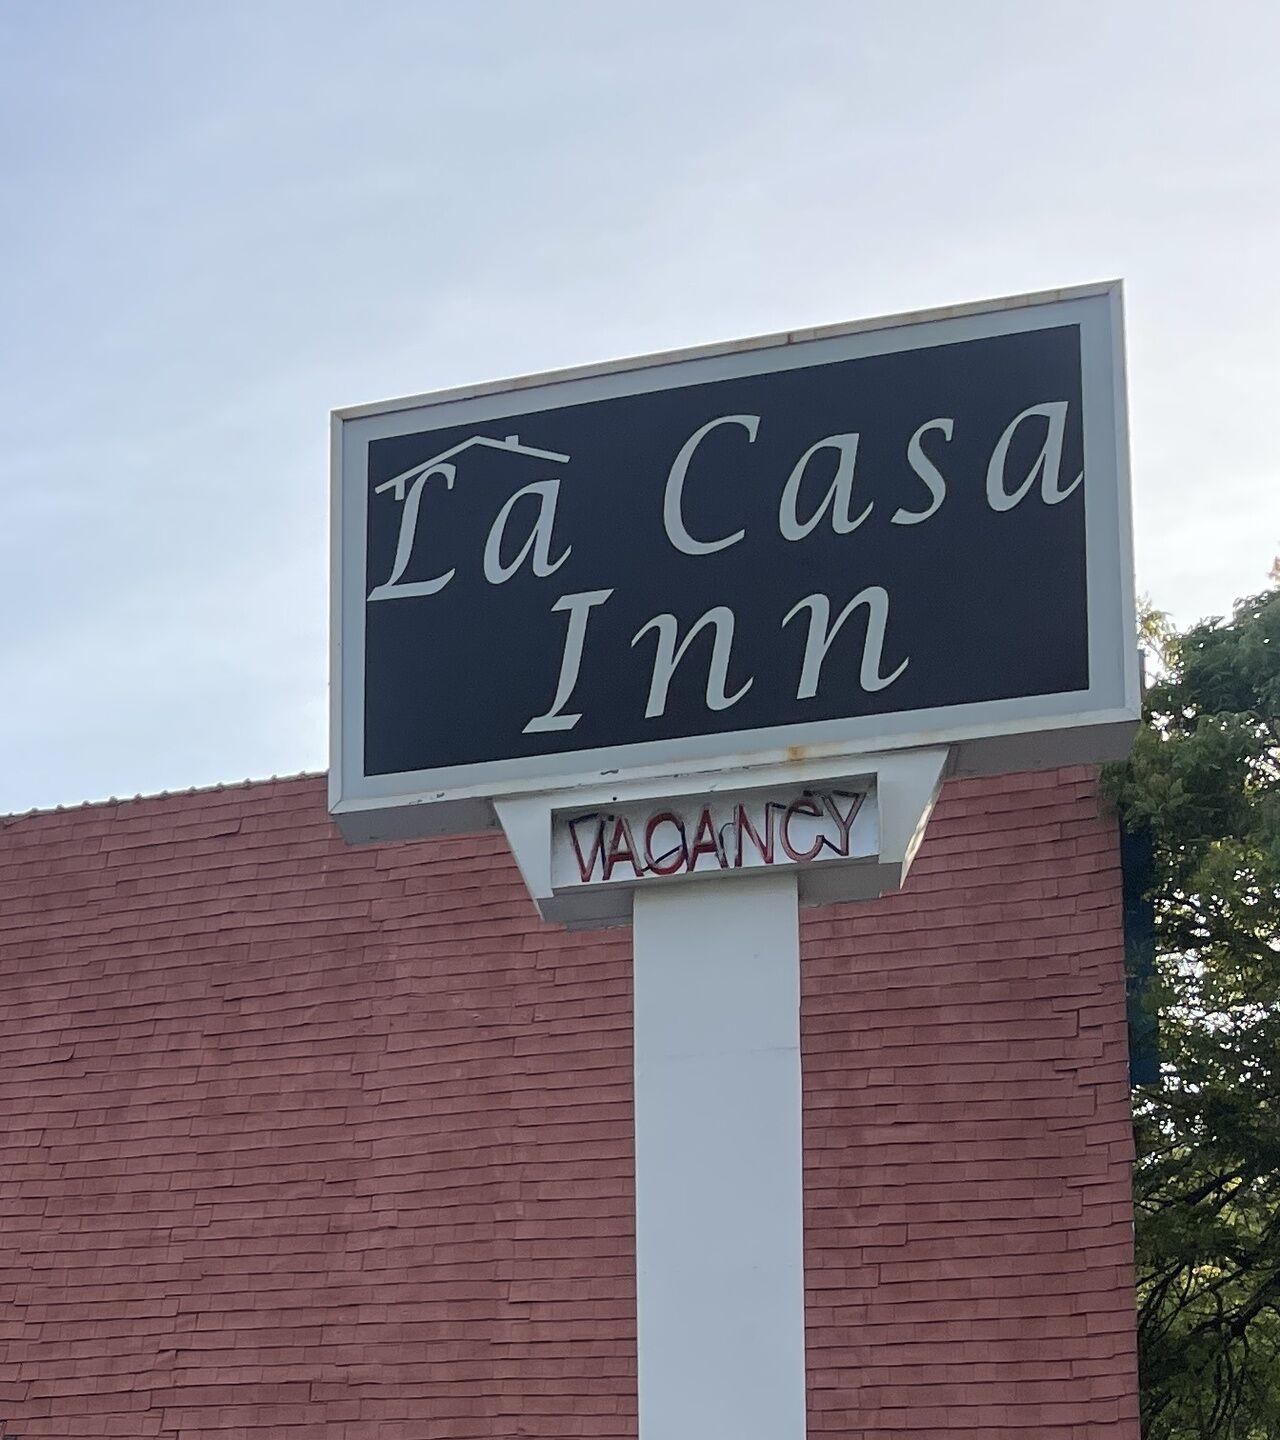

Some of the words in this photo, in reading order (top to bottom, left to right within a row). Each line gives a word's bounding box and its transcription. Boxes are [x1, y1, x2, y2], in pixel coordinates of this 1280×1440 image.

[368, 463, 572, 601] La
[663, 400, 1084, 556] Casa
[522, 585, 910, 735] Inn
